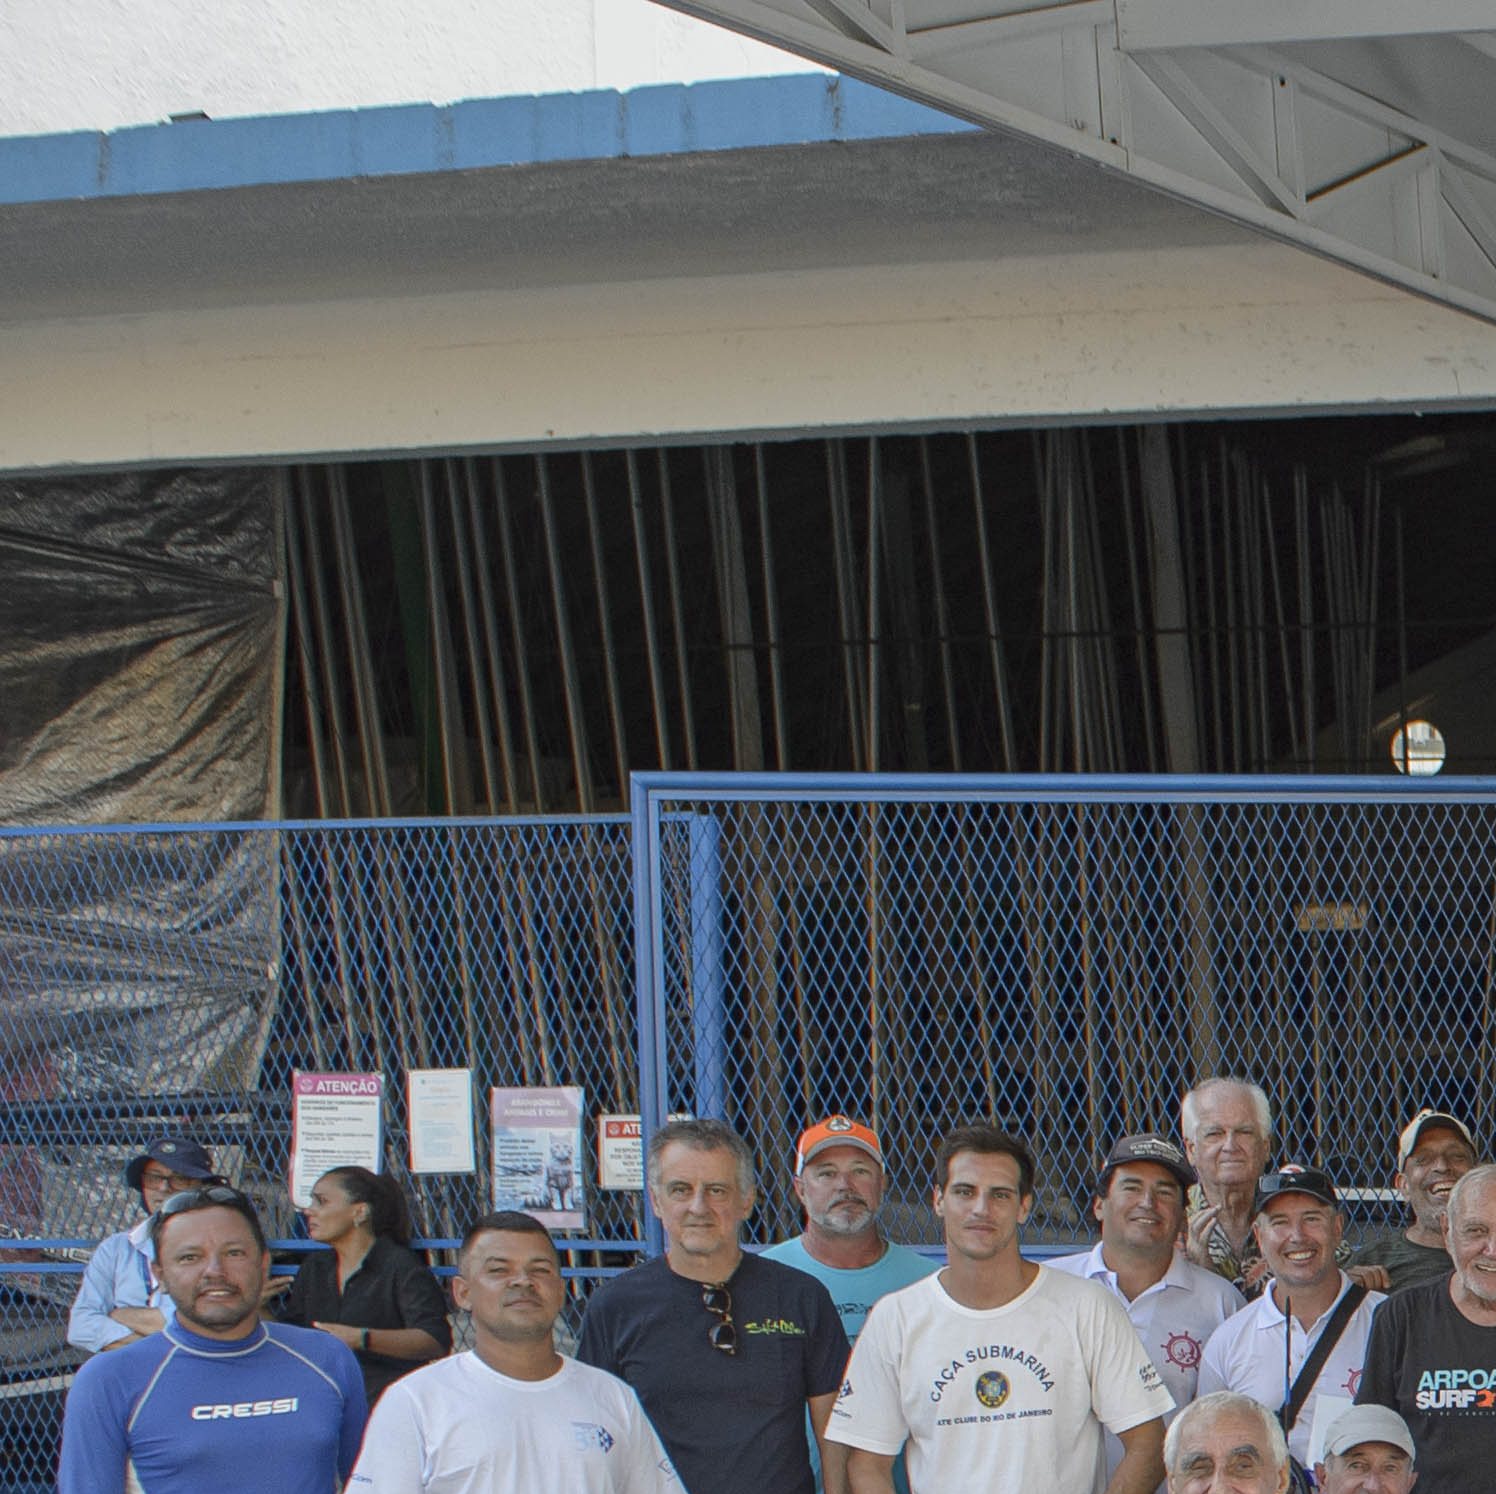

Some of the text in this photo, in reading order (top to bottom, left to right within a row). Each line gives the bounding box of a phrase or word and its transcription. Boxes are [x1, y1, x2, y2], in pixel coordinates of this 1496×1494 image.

[316, 1079, 377, 1094] ATENÇÃO
[931, 1345, 1055, 1402] CAÇA SUBMARINA
[191, 1397, 298, 1420] CRESSI
[1416, 1390, 1476, 1409] SURF
[954, 1416, 978, 1425] CLUBE
[1018, 1409, 1053, 1418] JANEIRO
